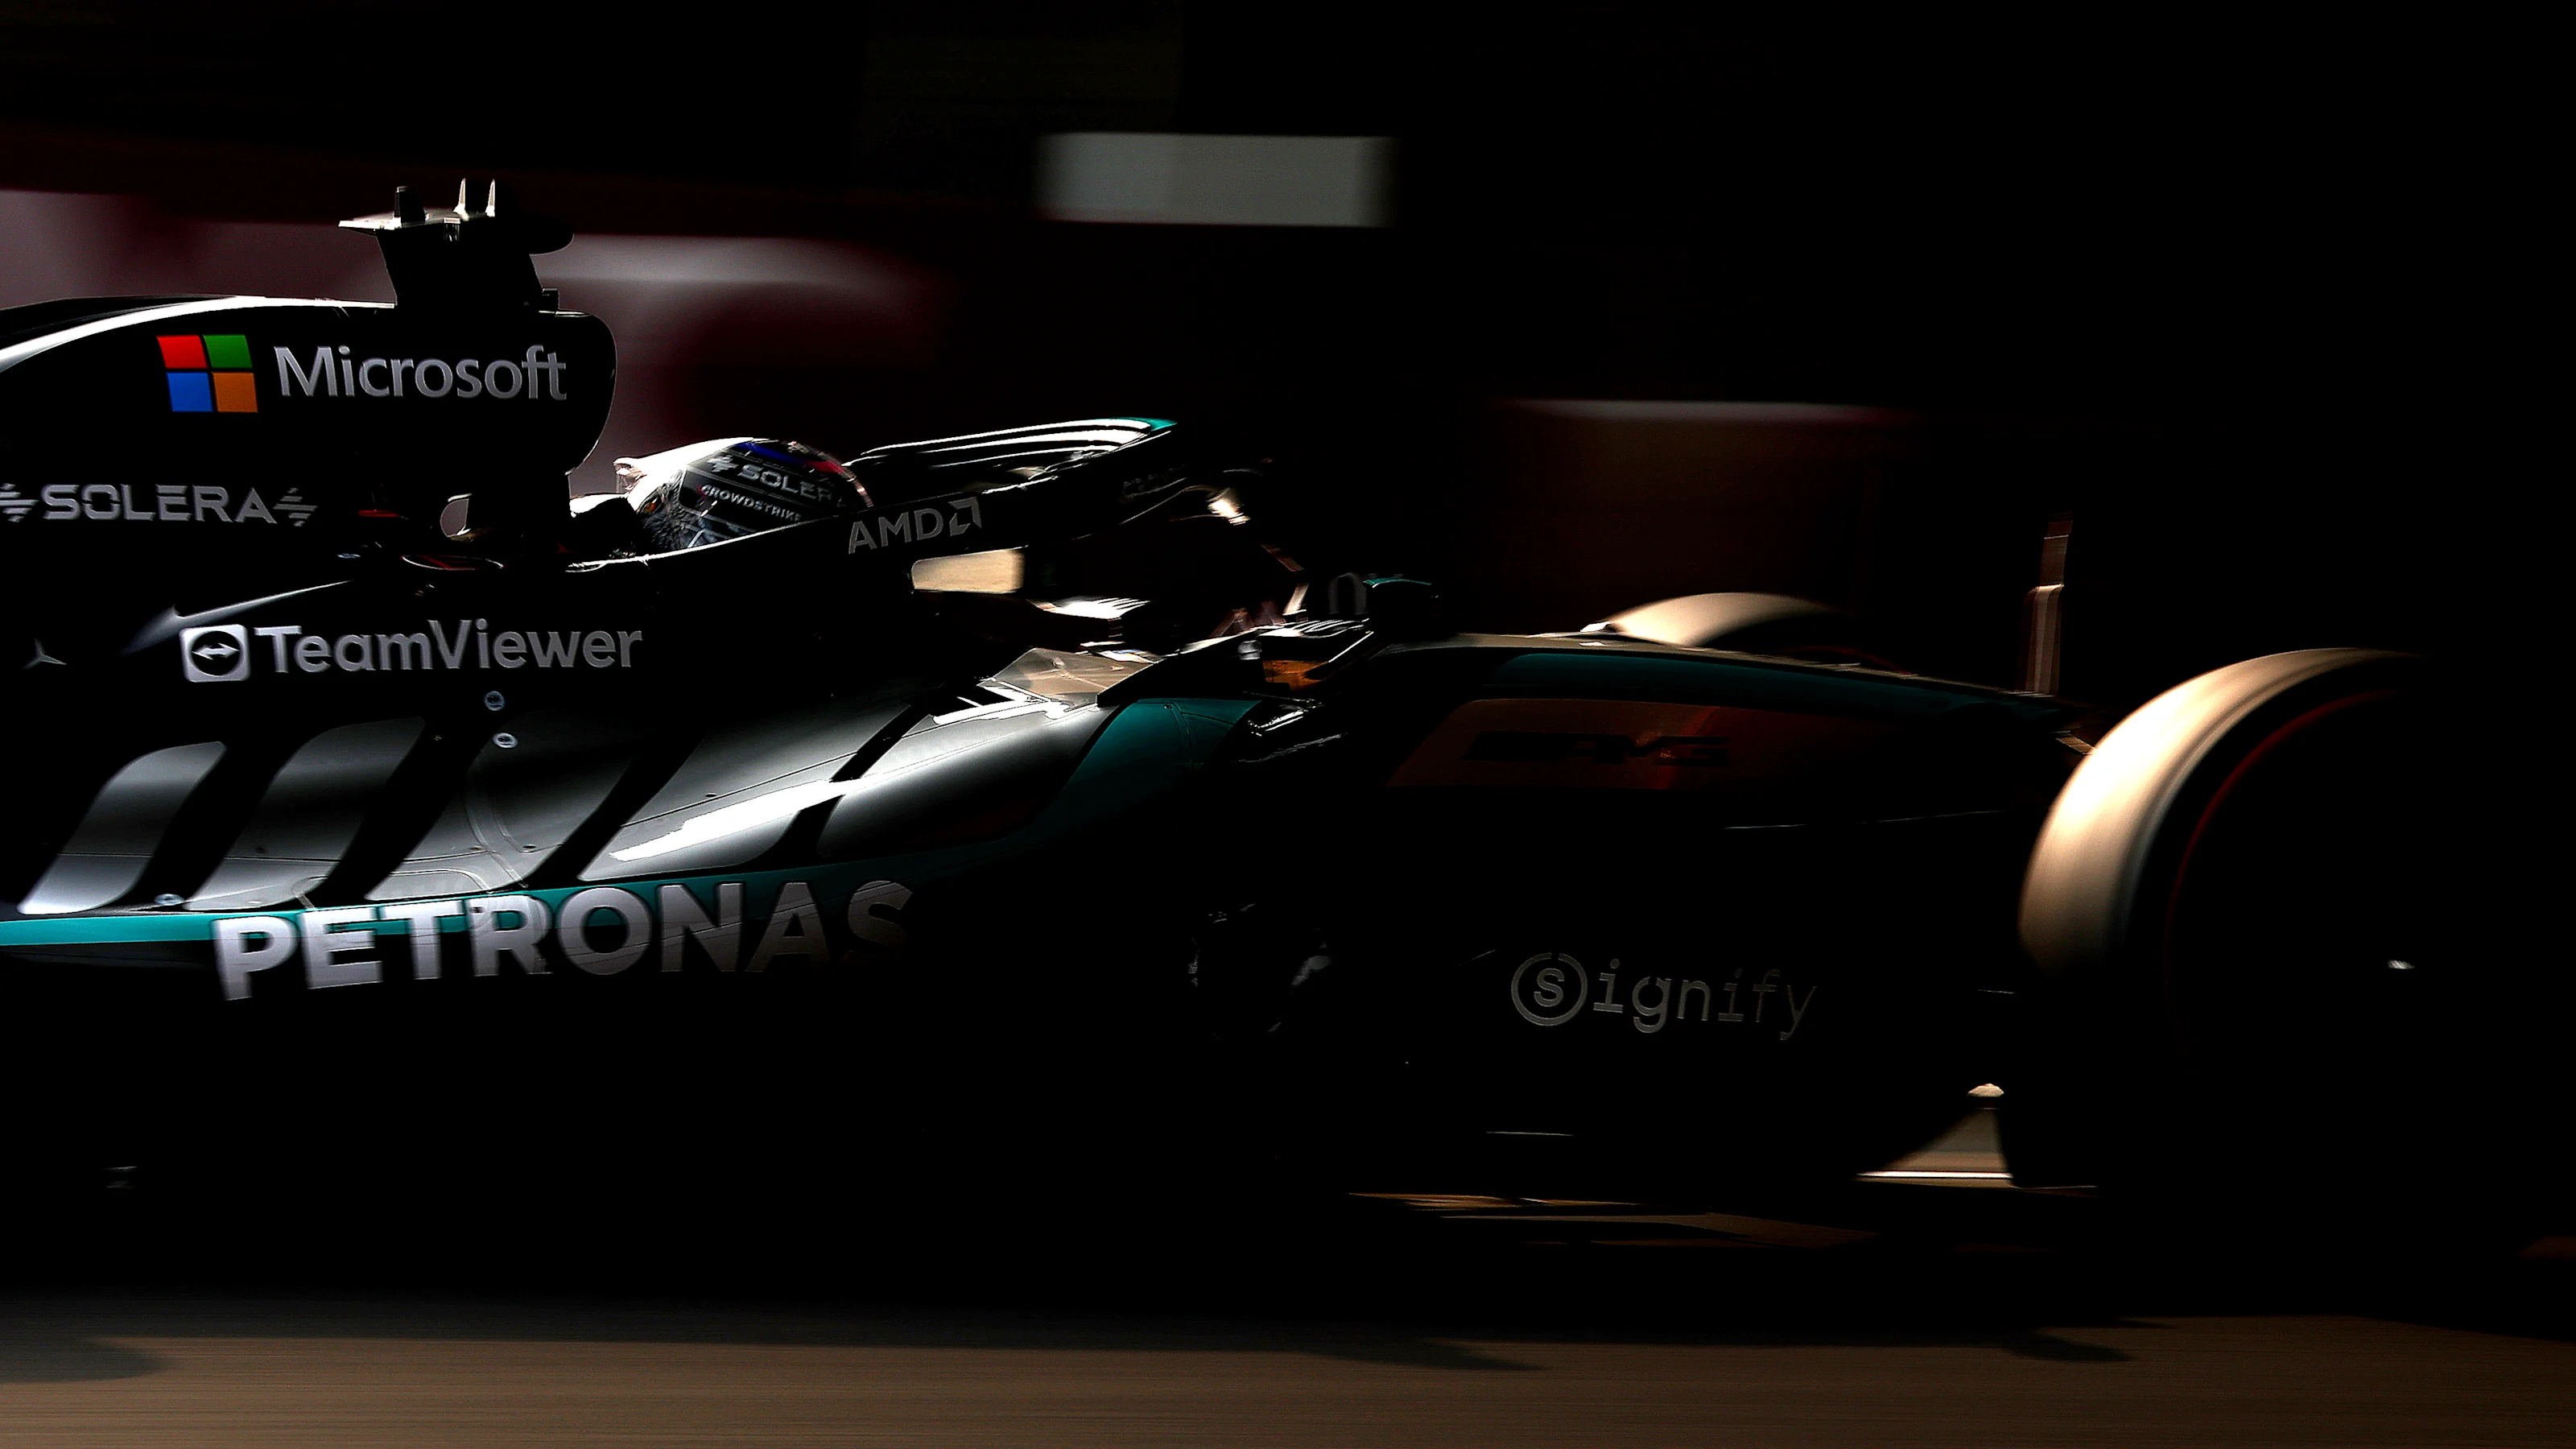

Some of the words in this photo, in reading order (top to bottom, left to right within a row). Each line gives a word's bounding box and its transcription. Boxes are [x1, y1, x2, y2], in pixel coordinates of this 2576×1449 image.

[274, 345, 568, 401] Microsoft
[41, 484, 277, 525] SOLERA
[701, 484, 803, 522] CROWDSTRIKE
[848, 507, 943, 555] AMD
[254, 619, 644, 674] TeamViewer
[211, 880, 913, 1002] PETRONAS
